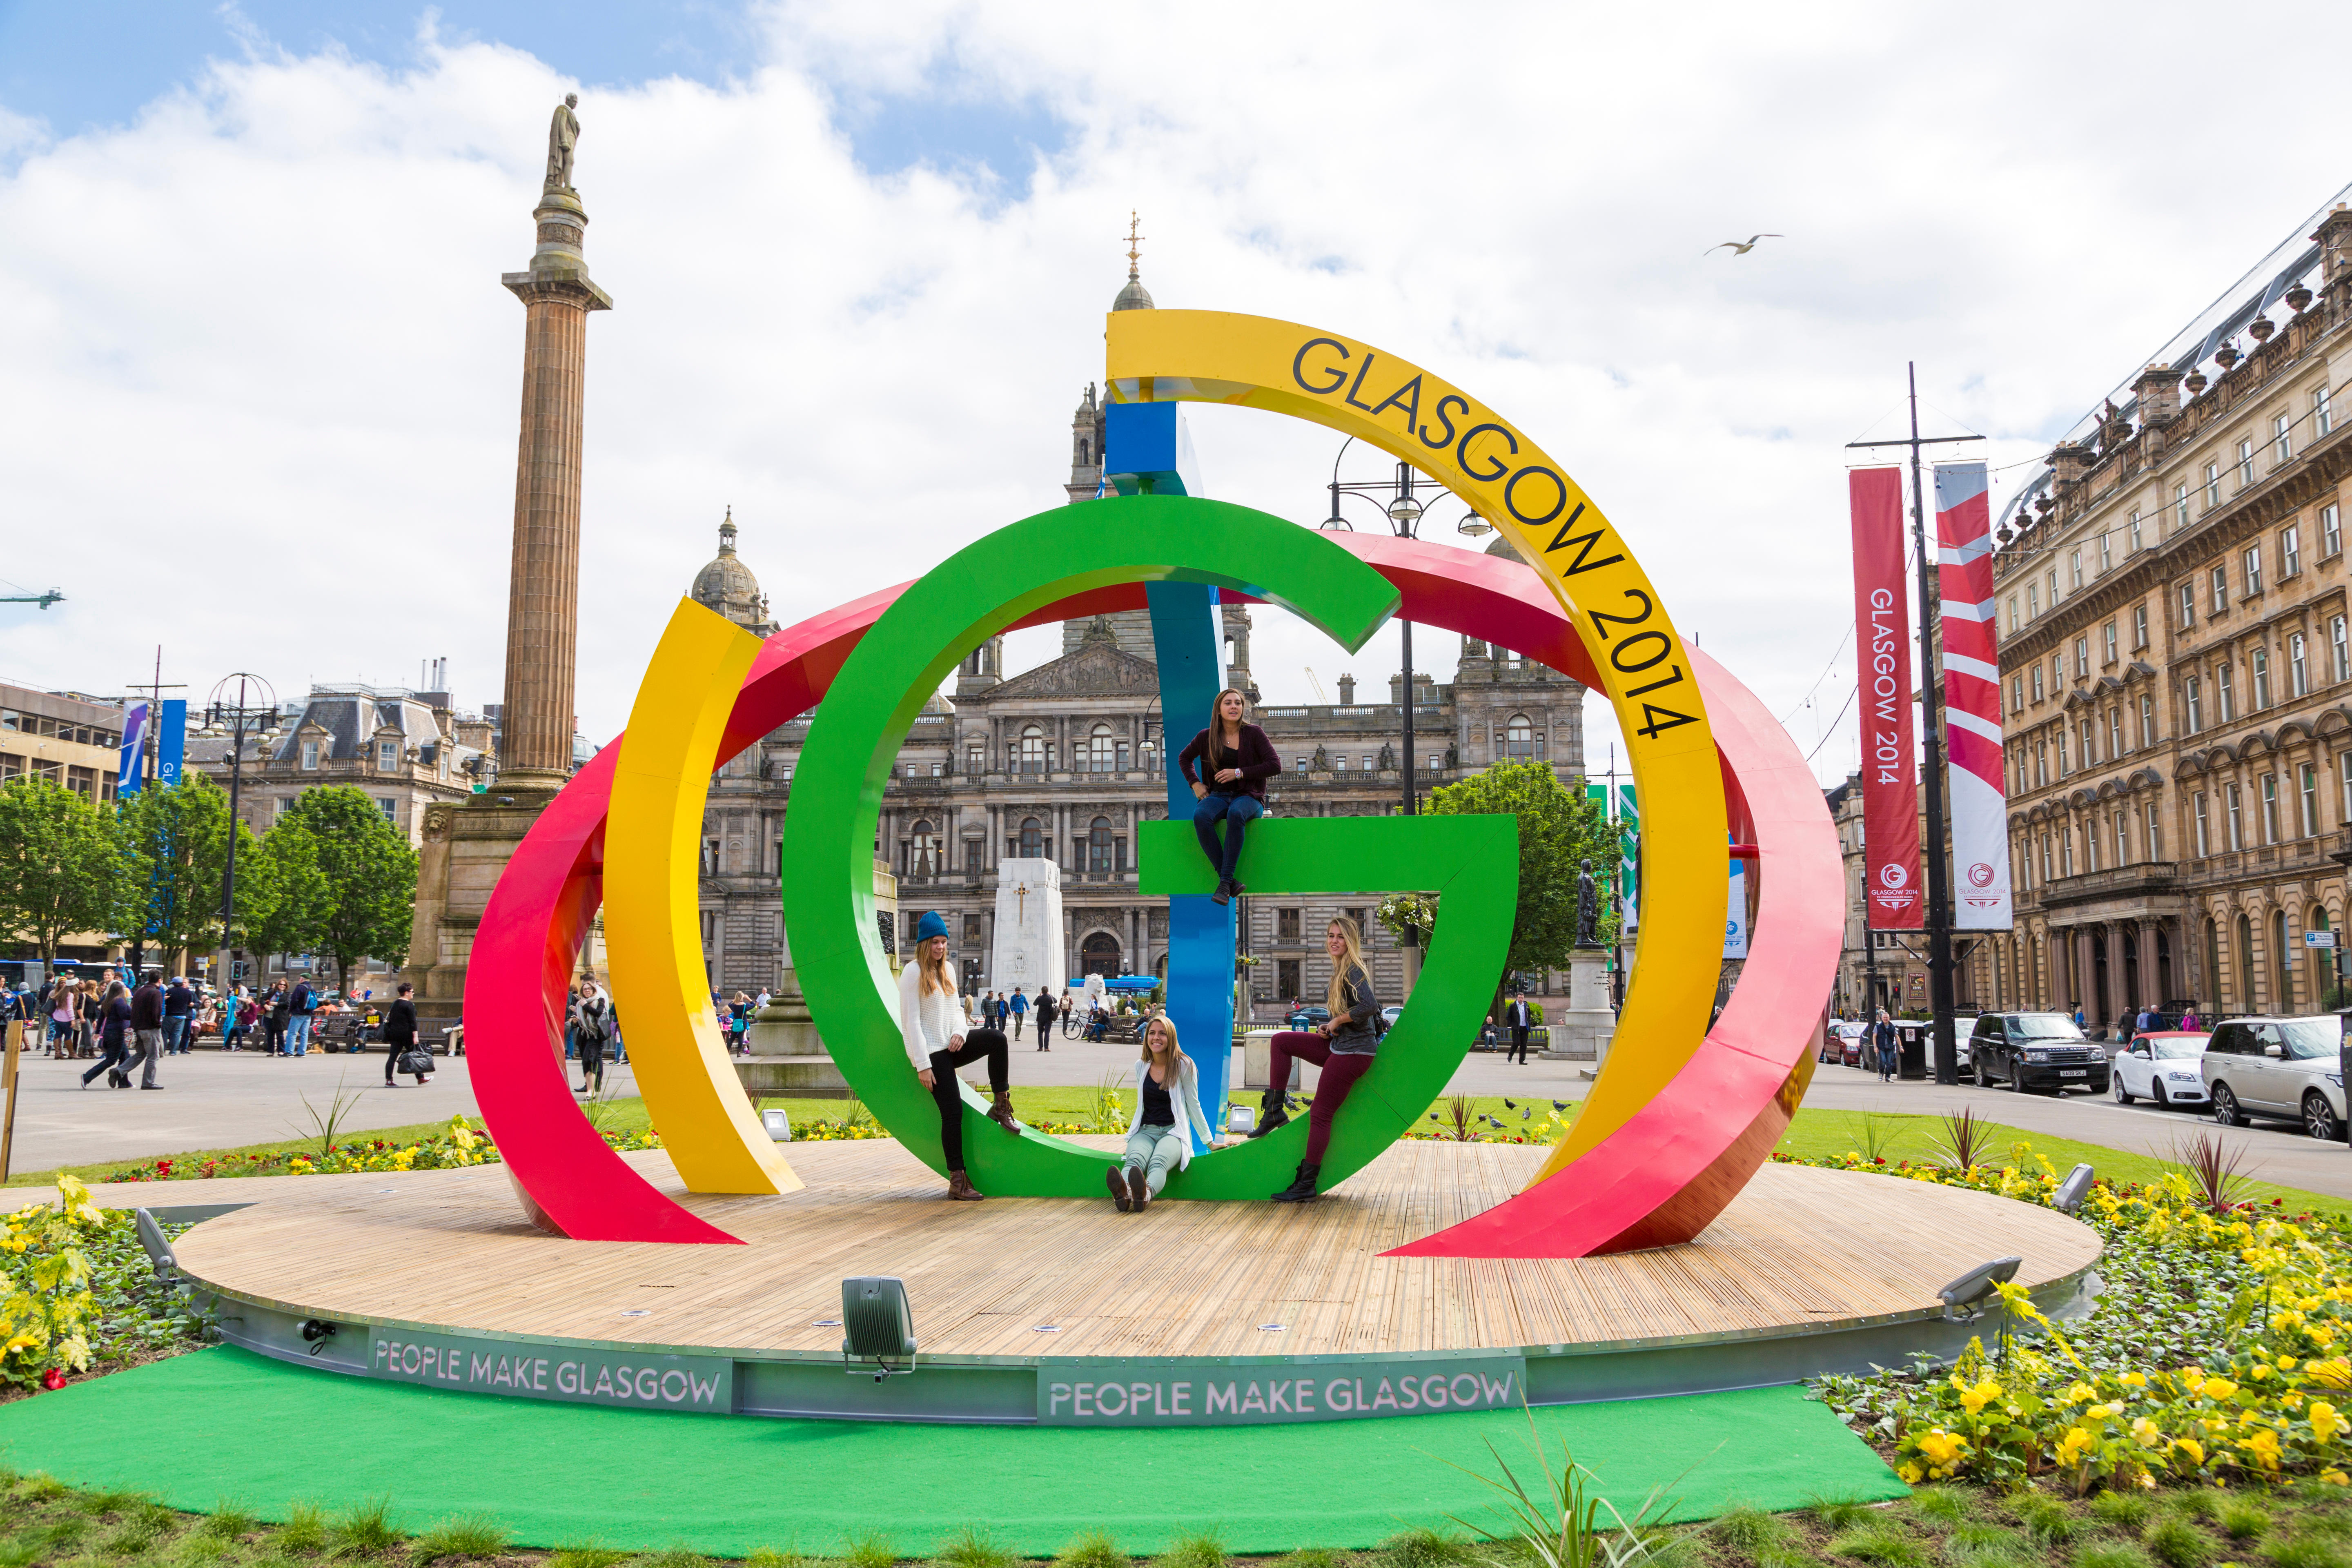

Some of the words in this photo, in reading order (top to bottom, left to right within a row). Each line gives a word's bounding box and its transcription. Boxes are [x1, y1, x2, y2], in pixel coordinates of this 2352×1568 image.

[1293, 338, 1625, 578] GLASGOW
[1587, 589, 1701, 740] 2014
[1871, 588, 1897, 722] GLASGOW
[1876, 731, 1899, 785] 2014
[374, 1339, 461, 1381] PEOPLE
[469, 1351, 548, 1391] MAKE
[555, 1361, 721, 1404] GLASGOW
[1050, 1381, 1192, 1416] PEOPLE
[1206, 1379, 1315, 1414] MAKE
[1325, 1370, 1514, 1412] GLASGOW
